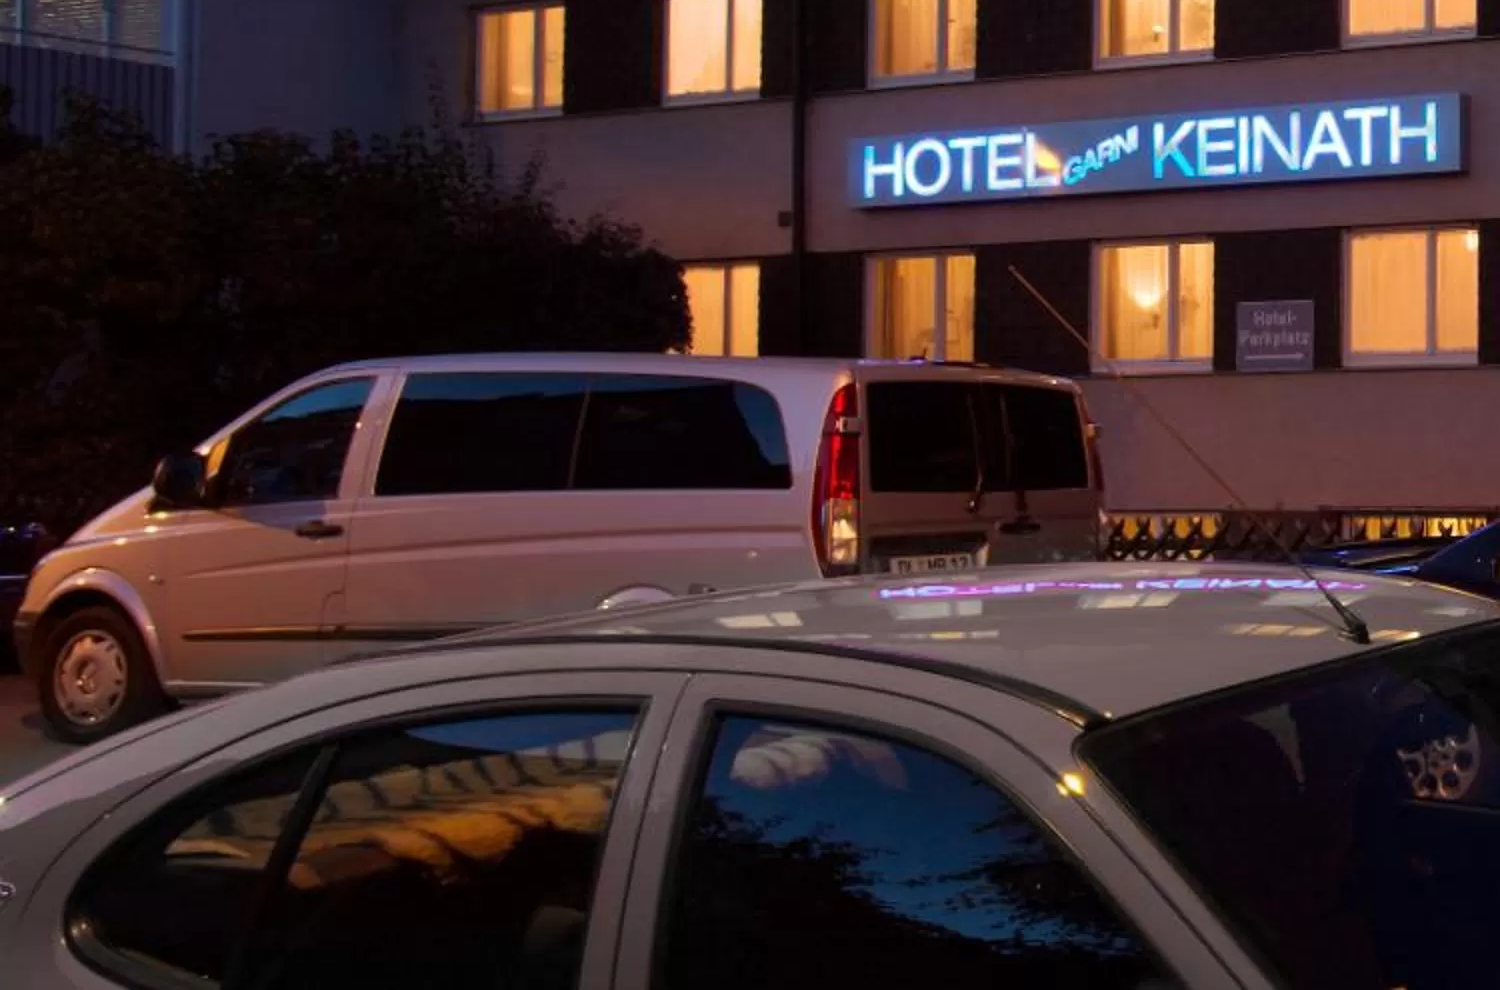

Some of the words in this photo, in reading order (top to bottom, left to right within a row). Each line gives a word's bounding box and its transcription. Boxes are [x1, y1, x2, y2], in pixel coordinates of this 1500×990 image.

[863, 132, 1061, 198] HOTEL
[1062, 125, 1139, 186] GARNI
[1153, 101, 1437, 179] KEINATH
